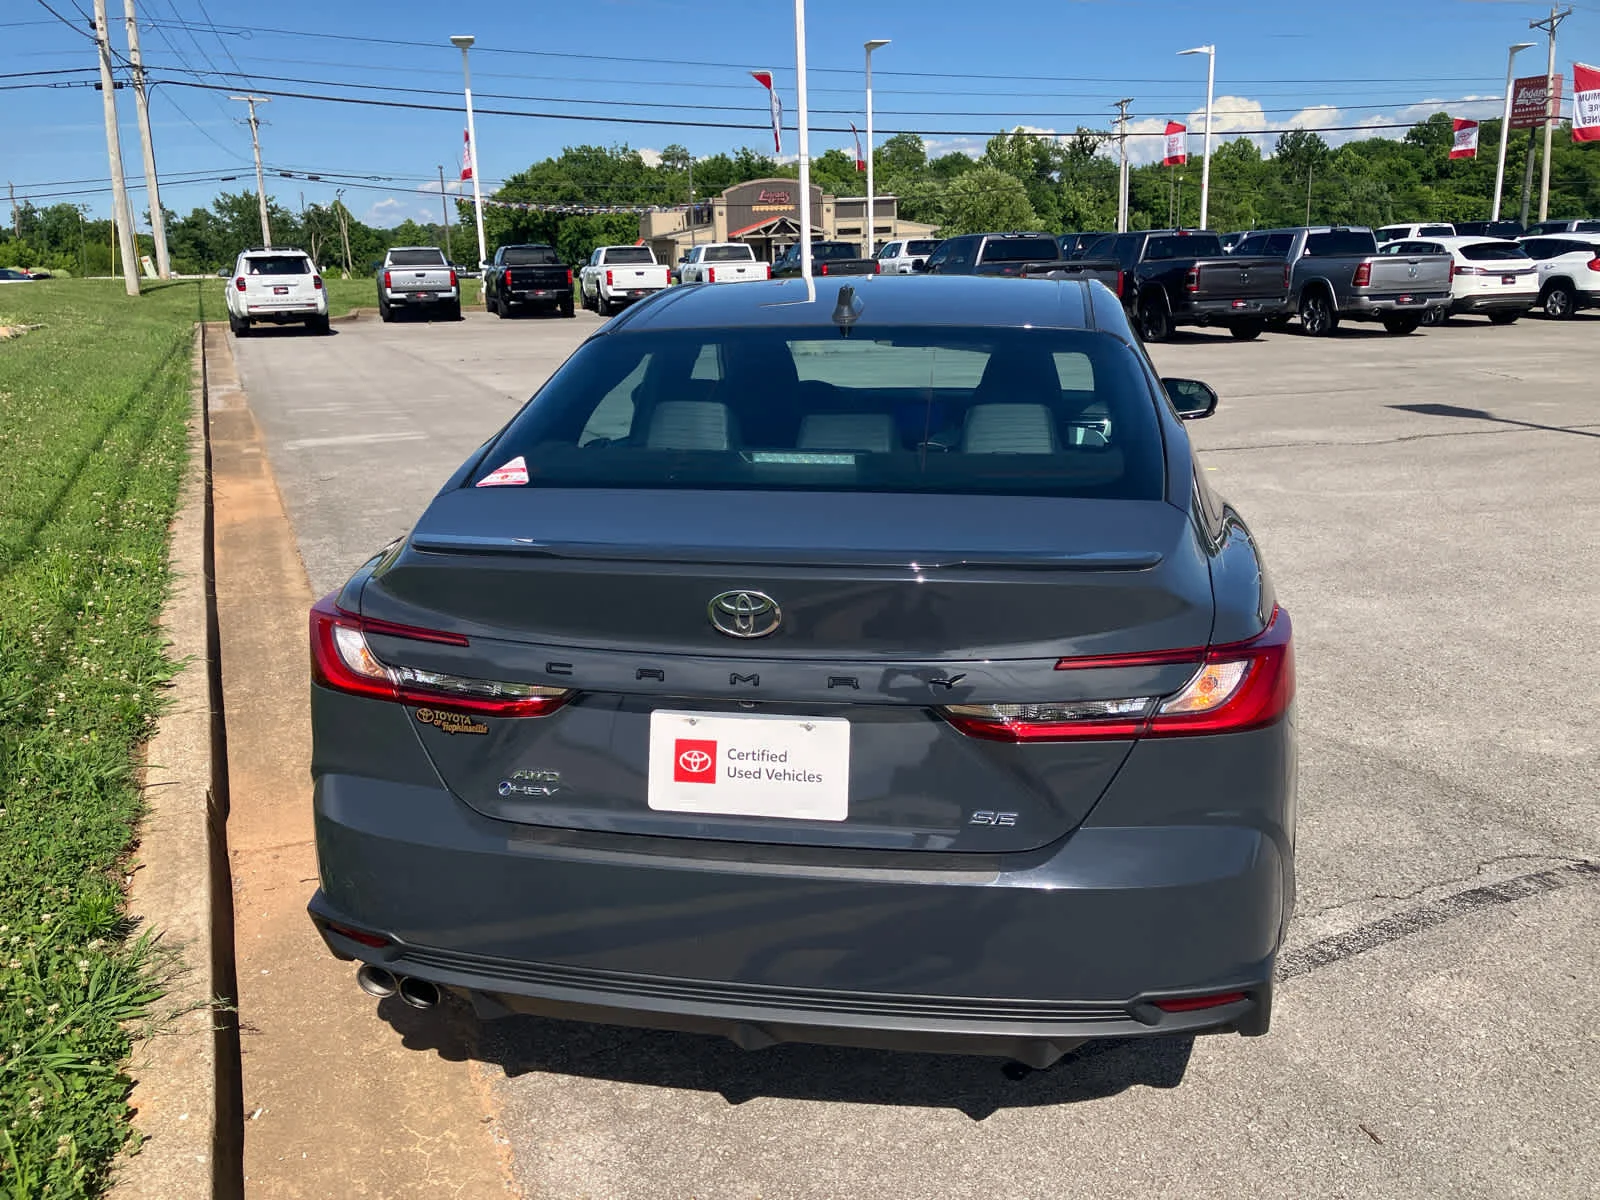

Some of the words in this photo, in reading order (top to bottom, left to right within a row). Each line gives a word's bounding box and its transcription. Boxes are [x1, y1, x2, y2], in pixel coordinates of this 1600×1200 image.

[545, 662, 967, 690] CAMRY
[434, 710, 471, 725] TOYOTA
[727, 748, 788, 763] Certified
[511, 769, 559, 781] AWD
[727, 766, 762, 780] Used
[765, 768, 823, 783] Vehicles
[968, 811, 1019, 827] SE
